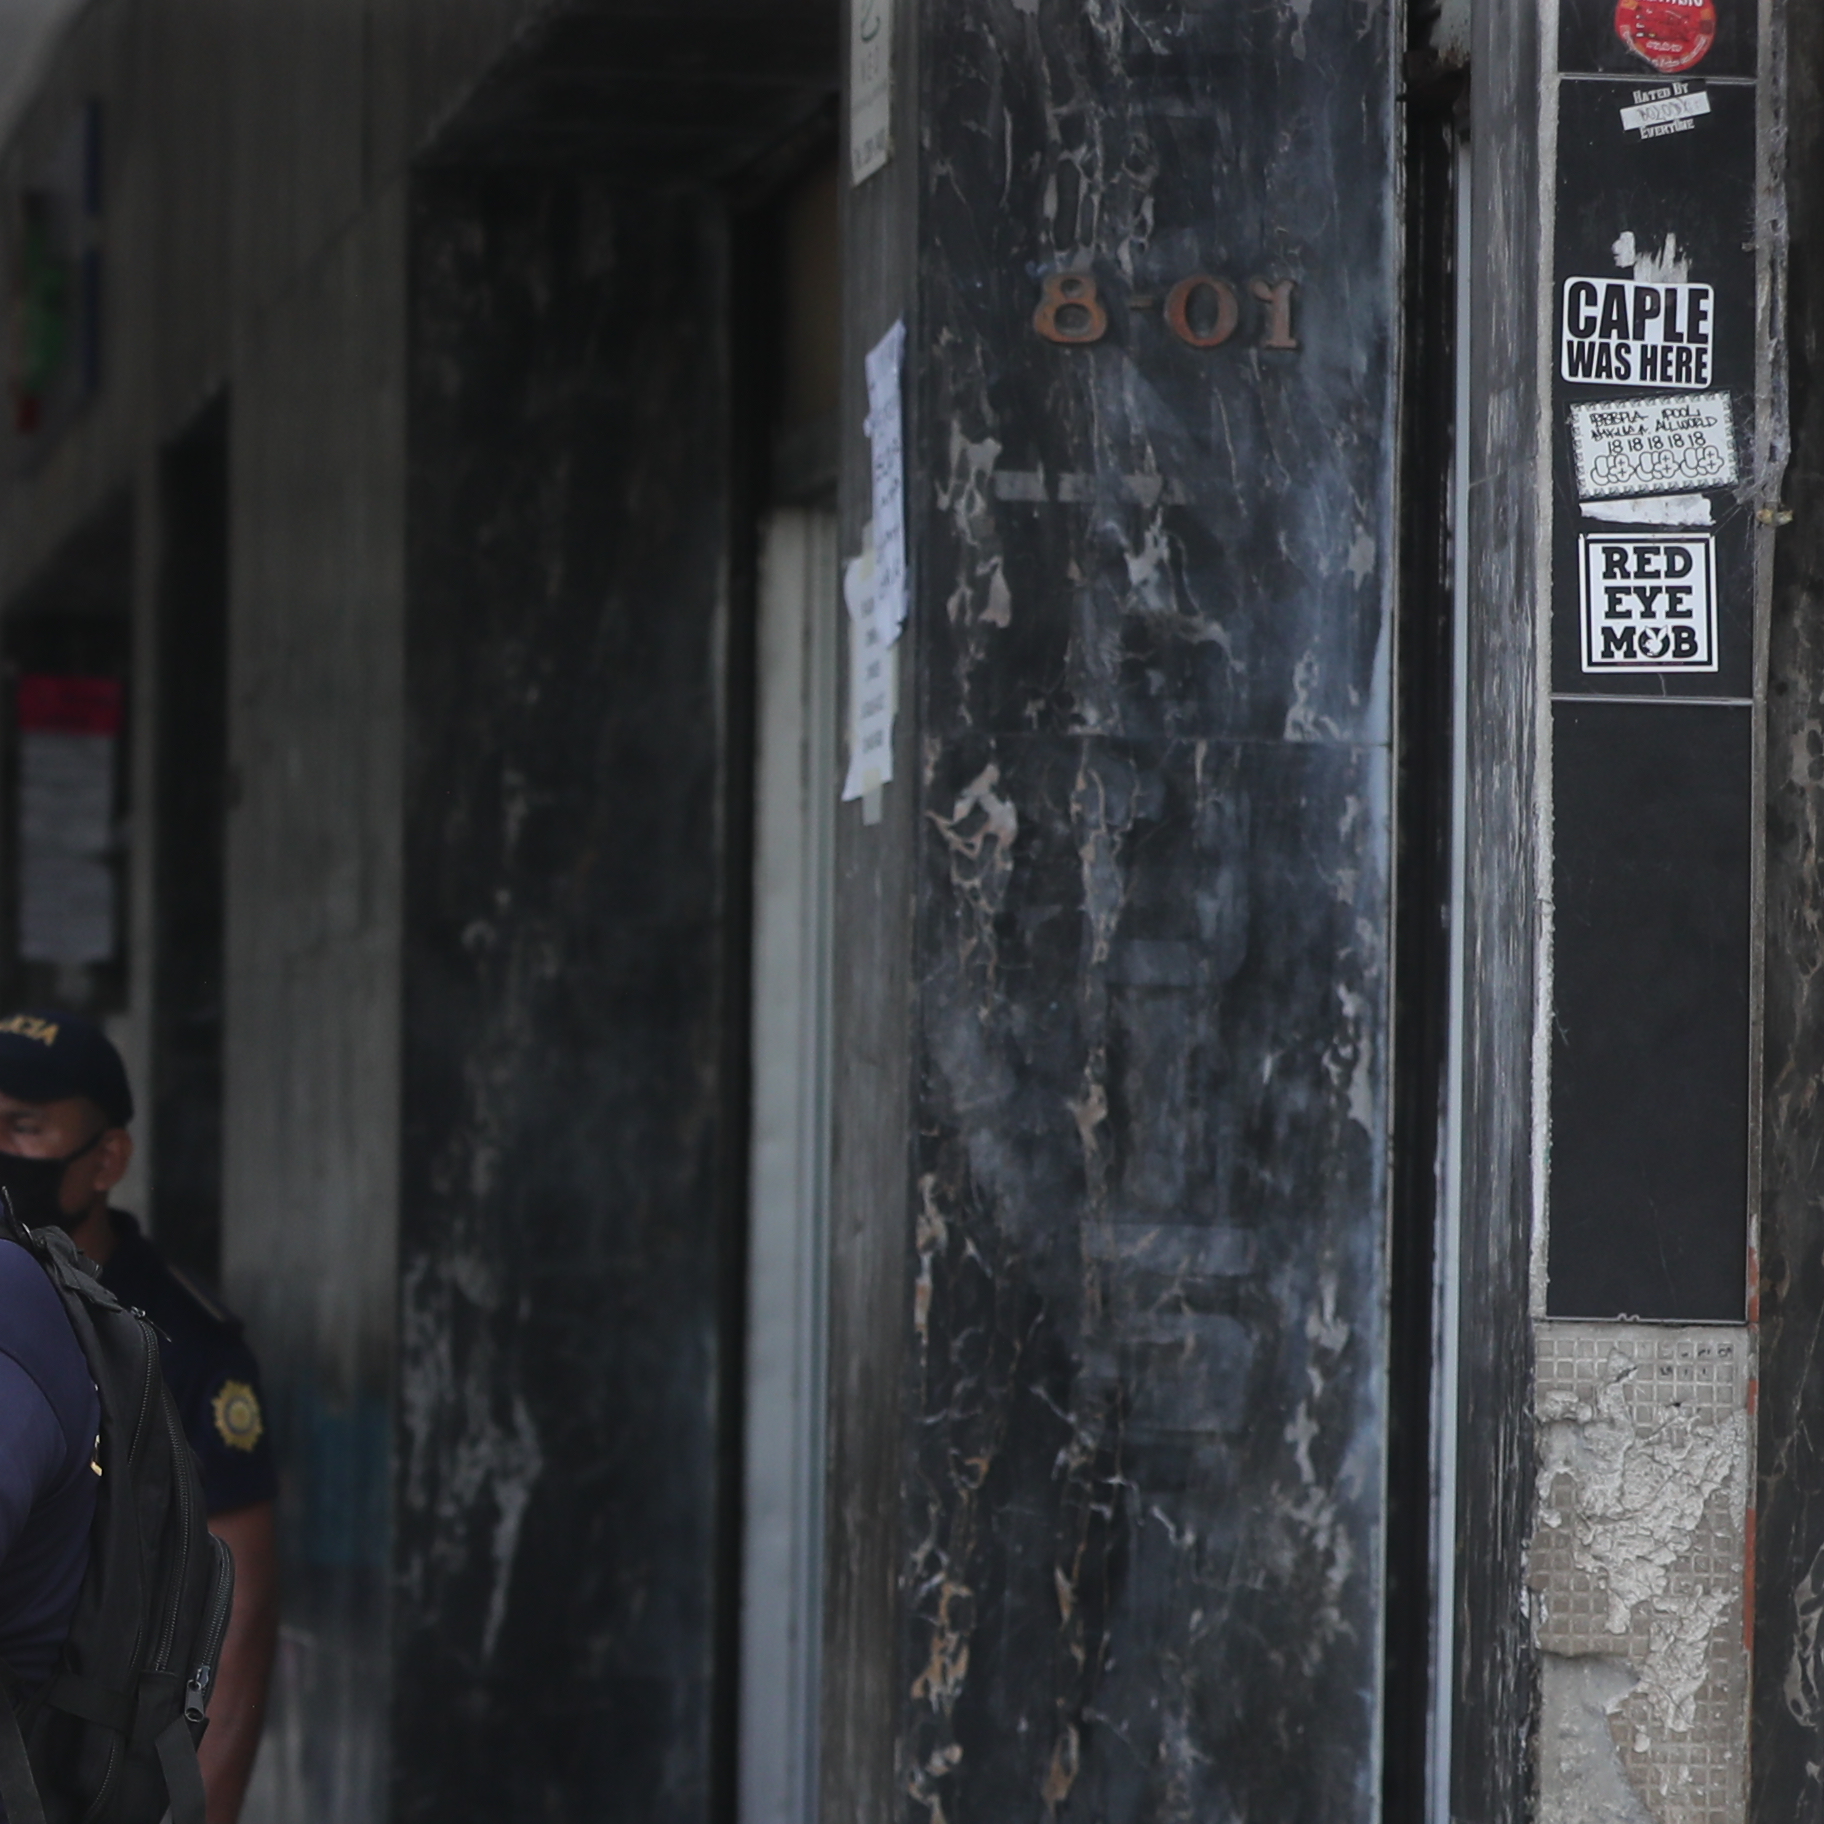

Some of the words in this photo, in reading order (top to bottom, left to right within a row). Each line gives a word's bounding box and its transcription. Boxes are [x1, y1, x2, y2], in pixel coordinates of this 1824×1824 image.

[1567, 281, 1709, 345] CAPLE
[1566, 340, 1631, 381] WAS
[1639, 345, 1708, 385] HERE
[1608, 439, 1623, 454] 18
[1628, 437, 1643, 452] 18
[1648, 435, 1664, 450] 18
[1668, 433, 1684, 448] 18
[1688, 431, 1706, 447] 18
[1602, 545, 1693, 580] RED
[1604, 585, 1693, 618] EYE
[1601, 625, 1698, 659] MOB
